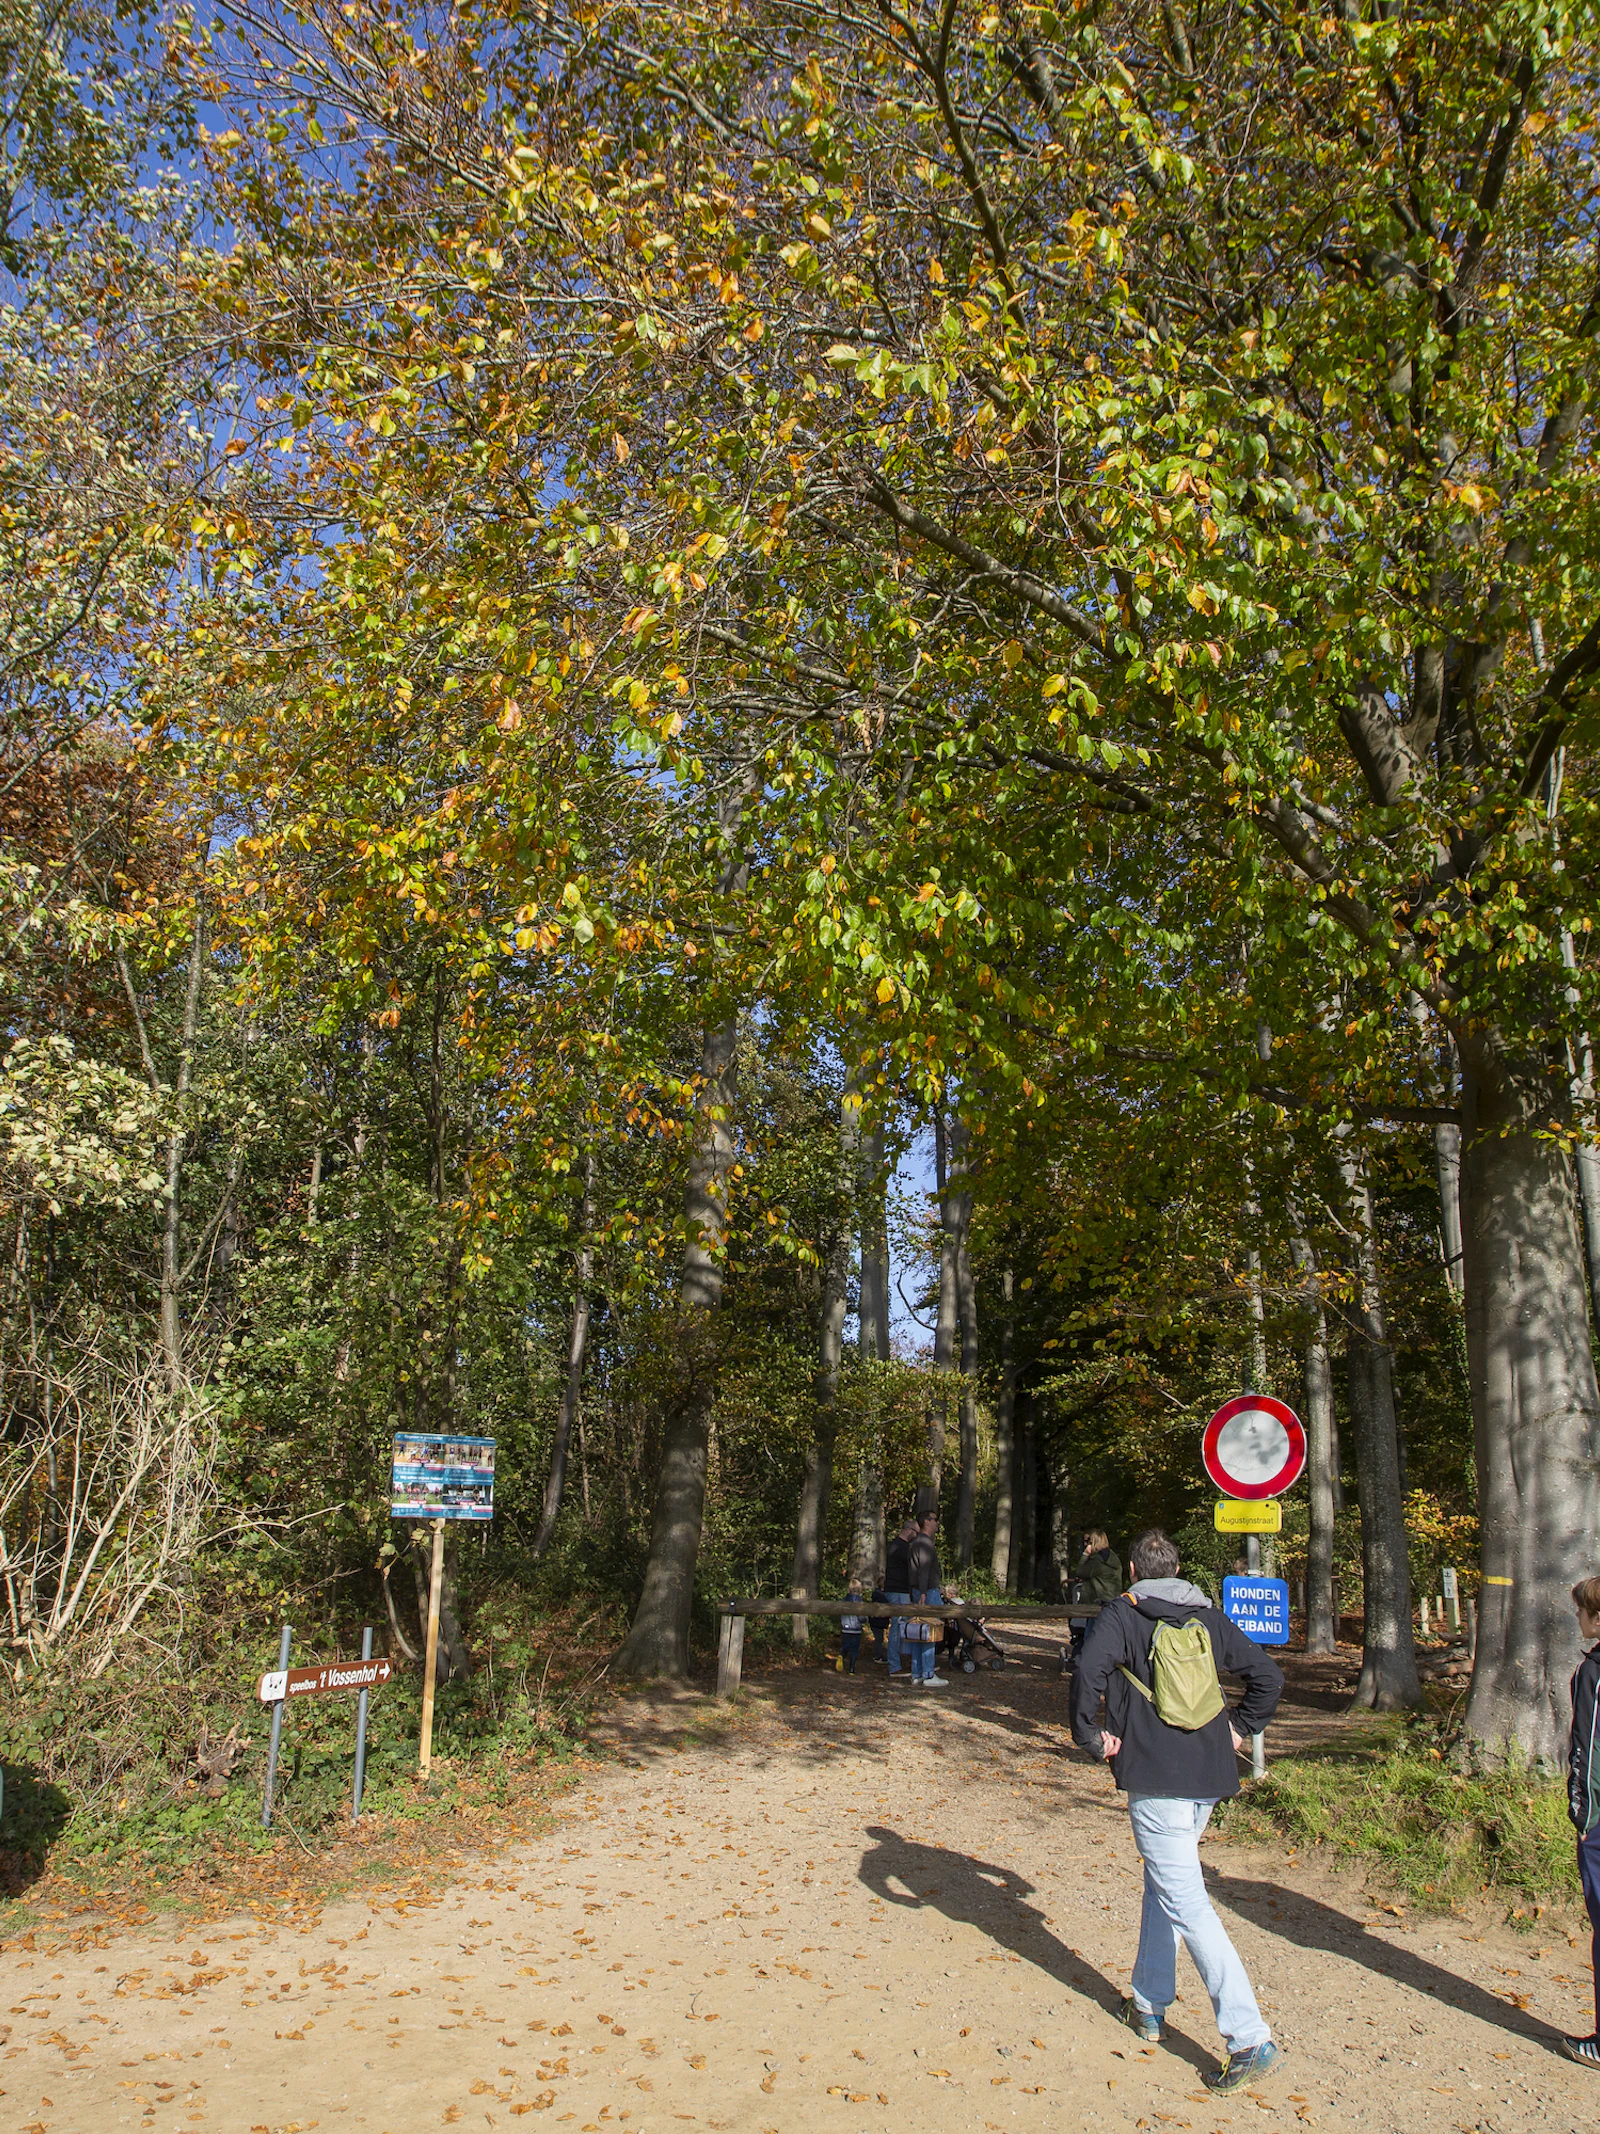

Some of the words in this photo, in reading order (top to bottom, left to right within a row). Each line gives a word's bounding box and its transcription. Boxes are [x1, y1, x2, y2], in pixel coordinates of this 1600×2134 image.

[1220, 1517, 1274, 1525] Augustijnstraat
[1230, 1587, 1281, 1601] HONDEN
[1231, 1603, 1258, 1616] AAN
[1264, 1605, 1281, 1617] DE
[1230, 1619, 1283, 1634] EIBAND
[289, 1679, 317, 1694] speelbos
[320, 1672, 327, 1688] 't
[328, 1664, 379, 1687] Vossenhol
